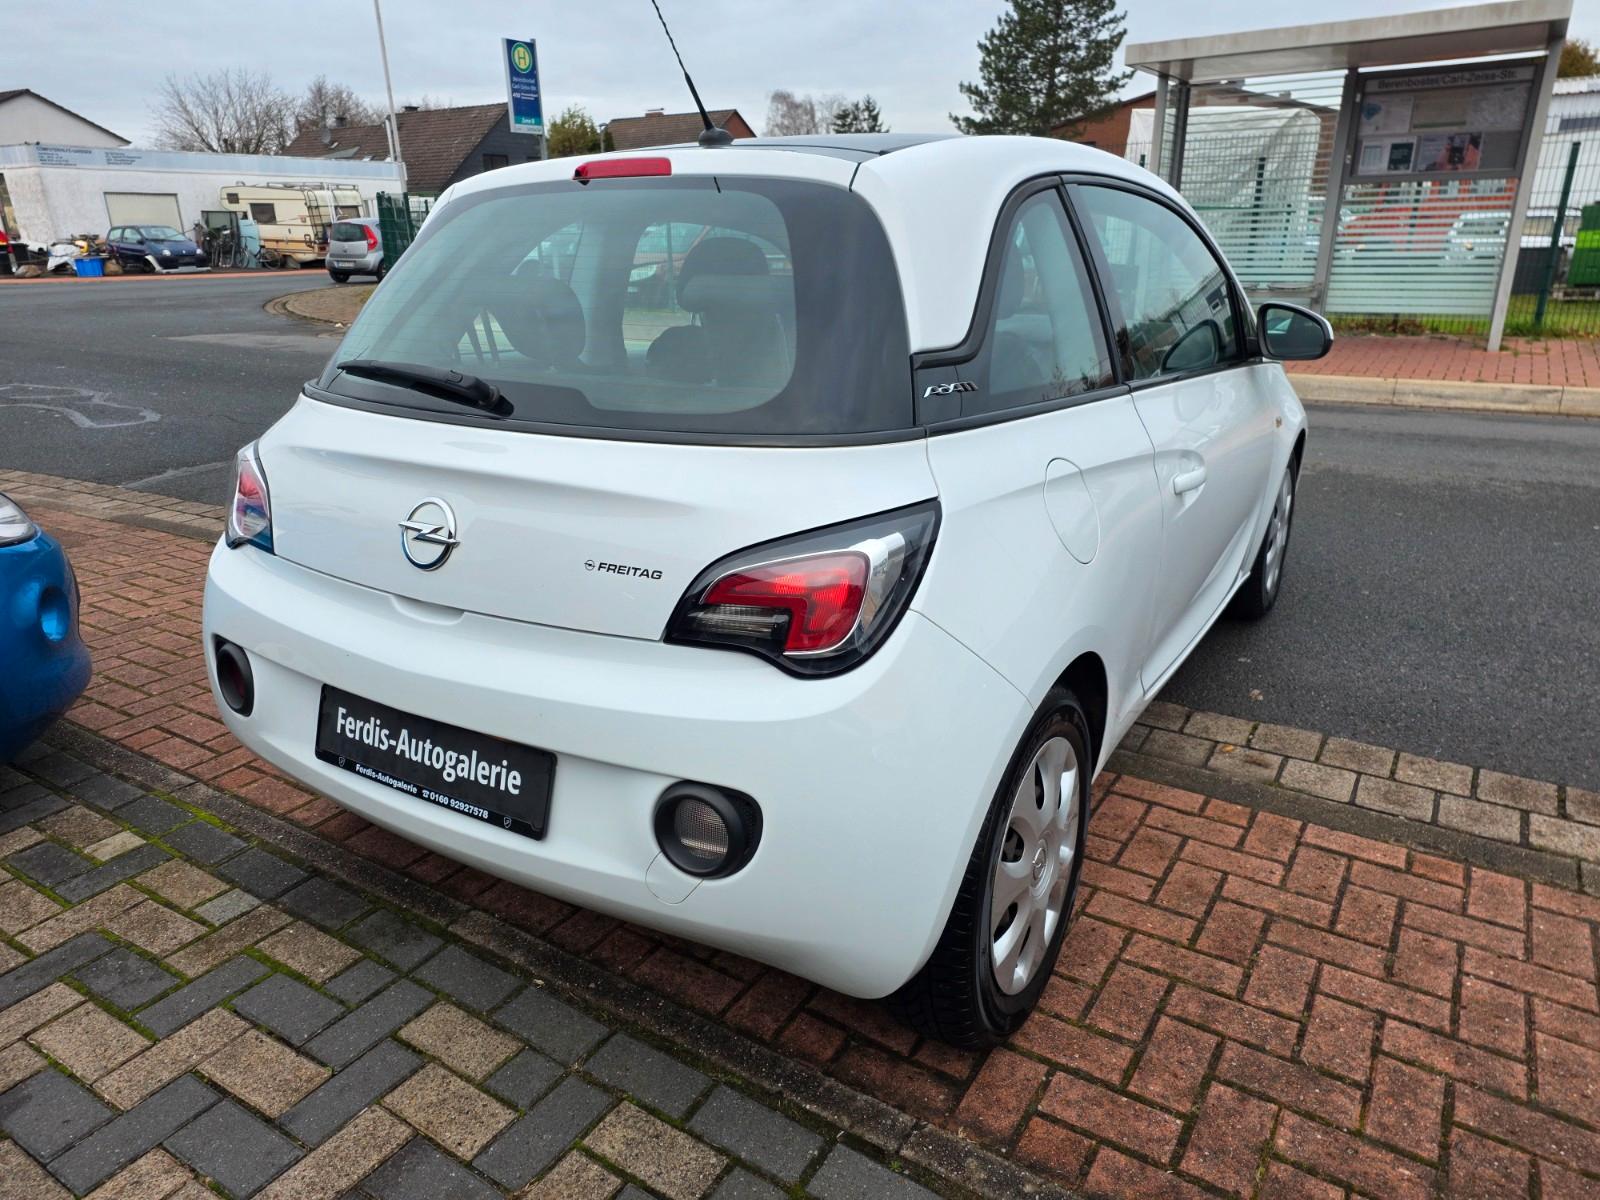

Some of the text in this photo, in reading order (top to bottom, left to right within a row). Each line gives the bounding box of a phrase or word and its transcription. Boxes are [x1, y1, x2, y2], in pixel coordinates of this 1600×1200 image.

[517, 48, 527, 66] H
[597, 562, 663, 580] FREITAG
[336, 706, 522, 795] Ferdis-Autogalerie
[355, 763, 489, 819] Ferdis-Autogalerie 0160 92927578
